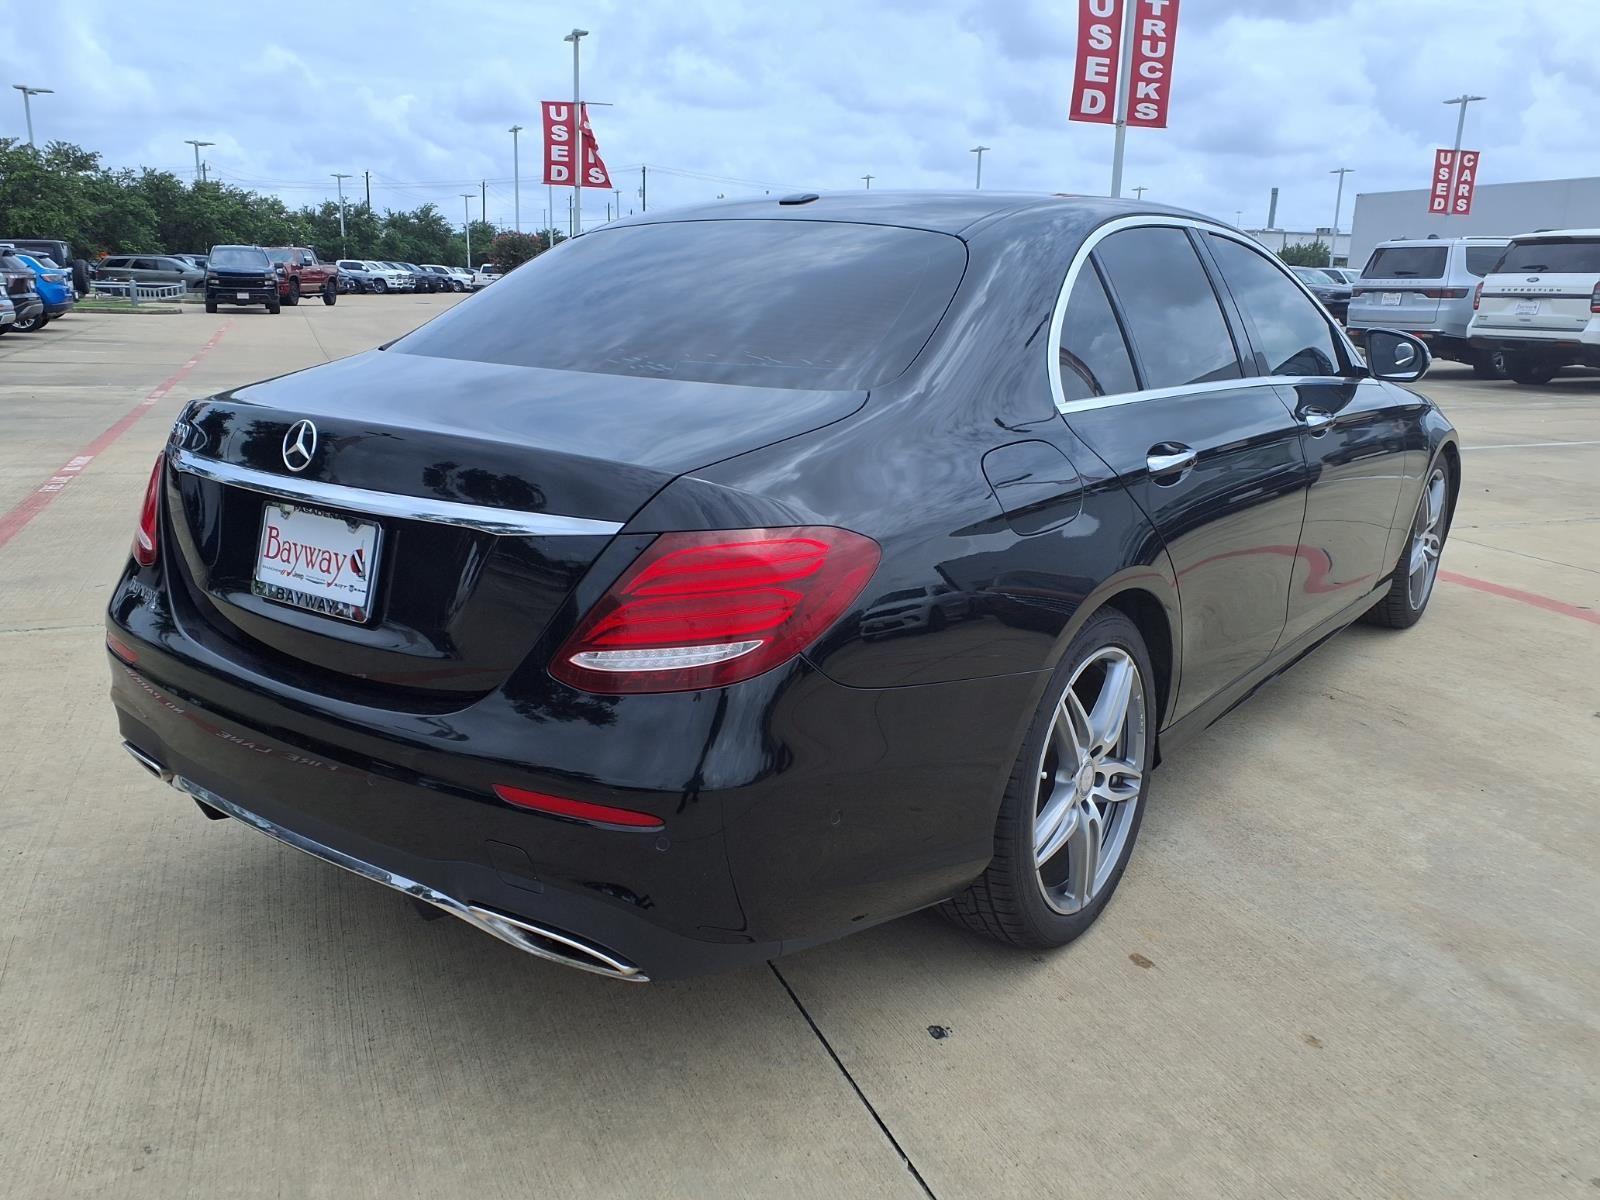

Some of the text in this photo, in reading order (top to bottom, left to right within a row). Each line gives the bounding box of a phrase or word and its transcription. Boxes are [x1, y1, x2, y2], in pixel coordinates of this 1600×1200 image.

[1080, 0, 1114, 115] USED
[1134, 0, 1170, 120] TRUCKS
[549, 105, 569, 181] USED
[1433, 152, 1452, 210] USED
[1456, 154, 1475, 211] CARS
[264, 525, 347, 588] Bayway
[276, 587, 337, 614] BAYWAY
